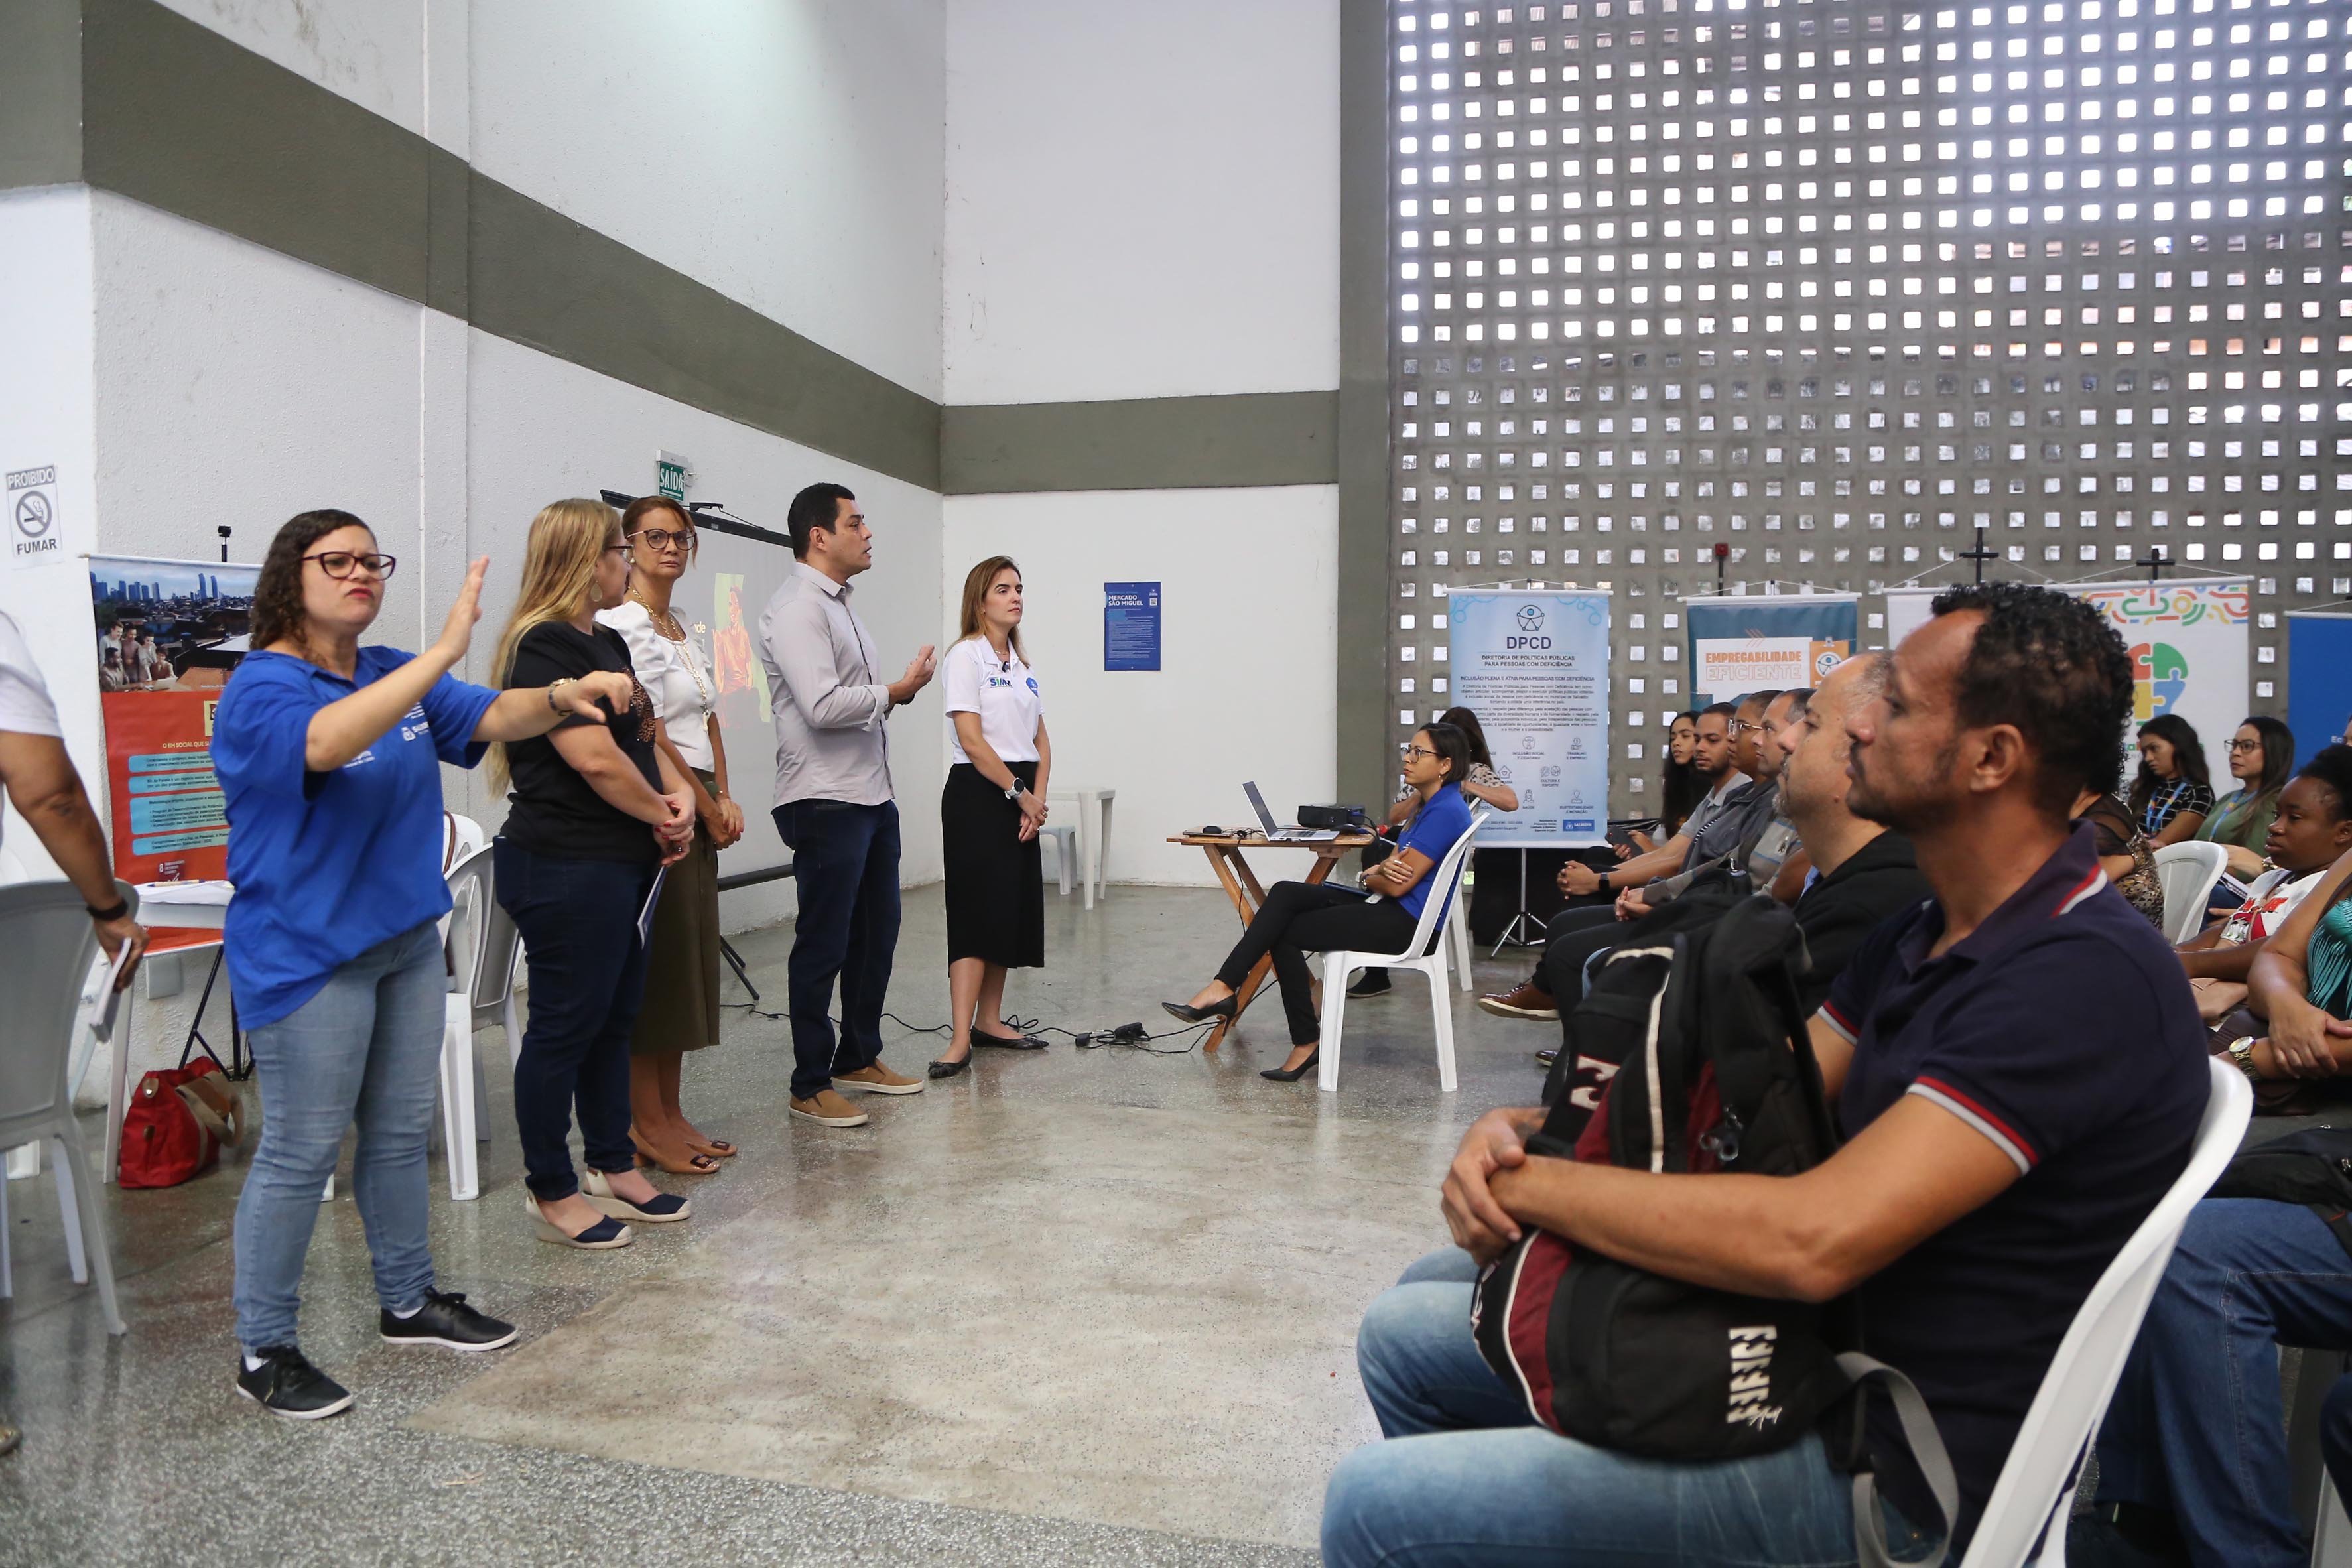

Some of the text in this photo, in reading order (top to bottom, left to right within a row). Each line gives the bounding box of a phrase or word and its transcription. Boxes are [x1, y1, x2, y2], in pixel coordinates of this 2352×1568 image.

[8, 467, 54, 489] PROIBIDO
[660, 467, 683, 491] SAÍDA
[17, 538, 57, 555] FUMAR
[1506, 637, 1551, 649] DPCD
[1705, 651, 1802, 663] EMPREGABILIDADE
[1705, 665, 1802, 681] EFICIENTE
[159, 863, 164, 872] 8
